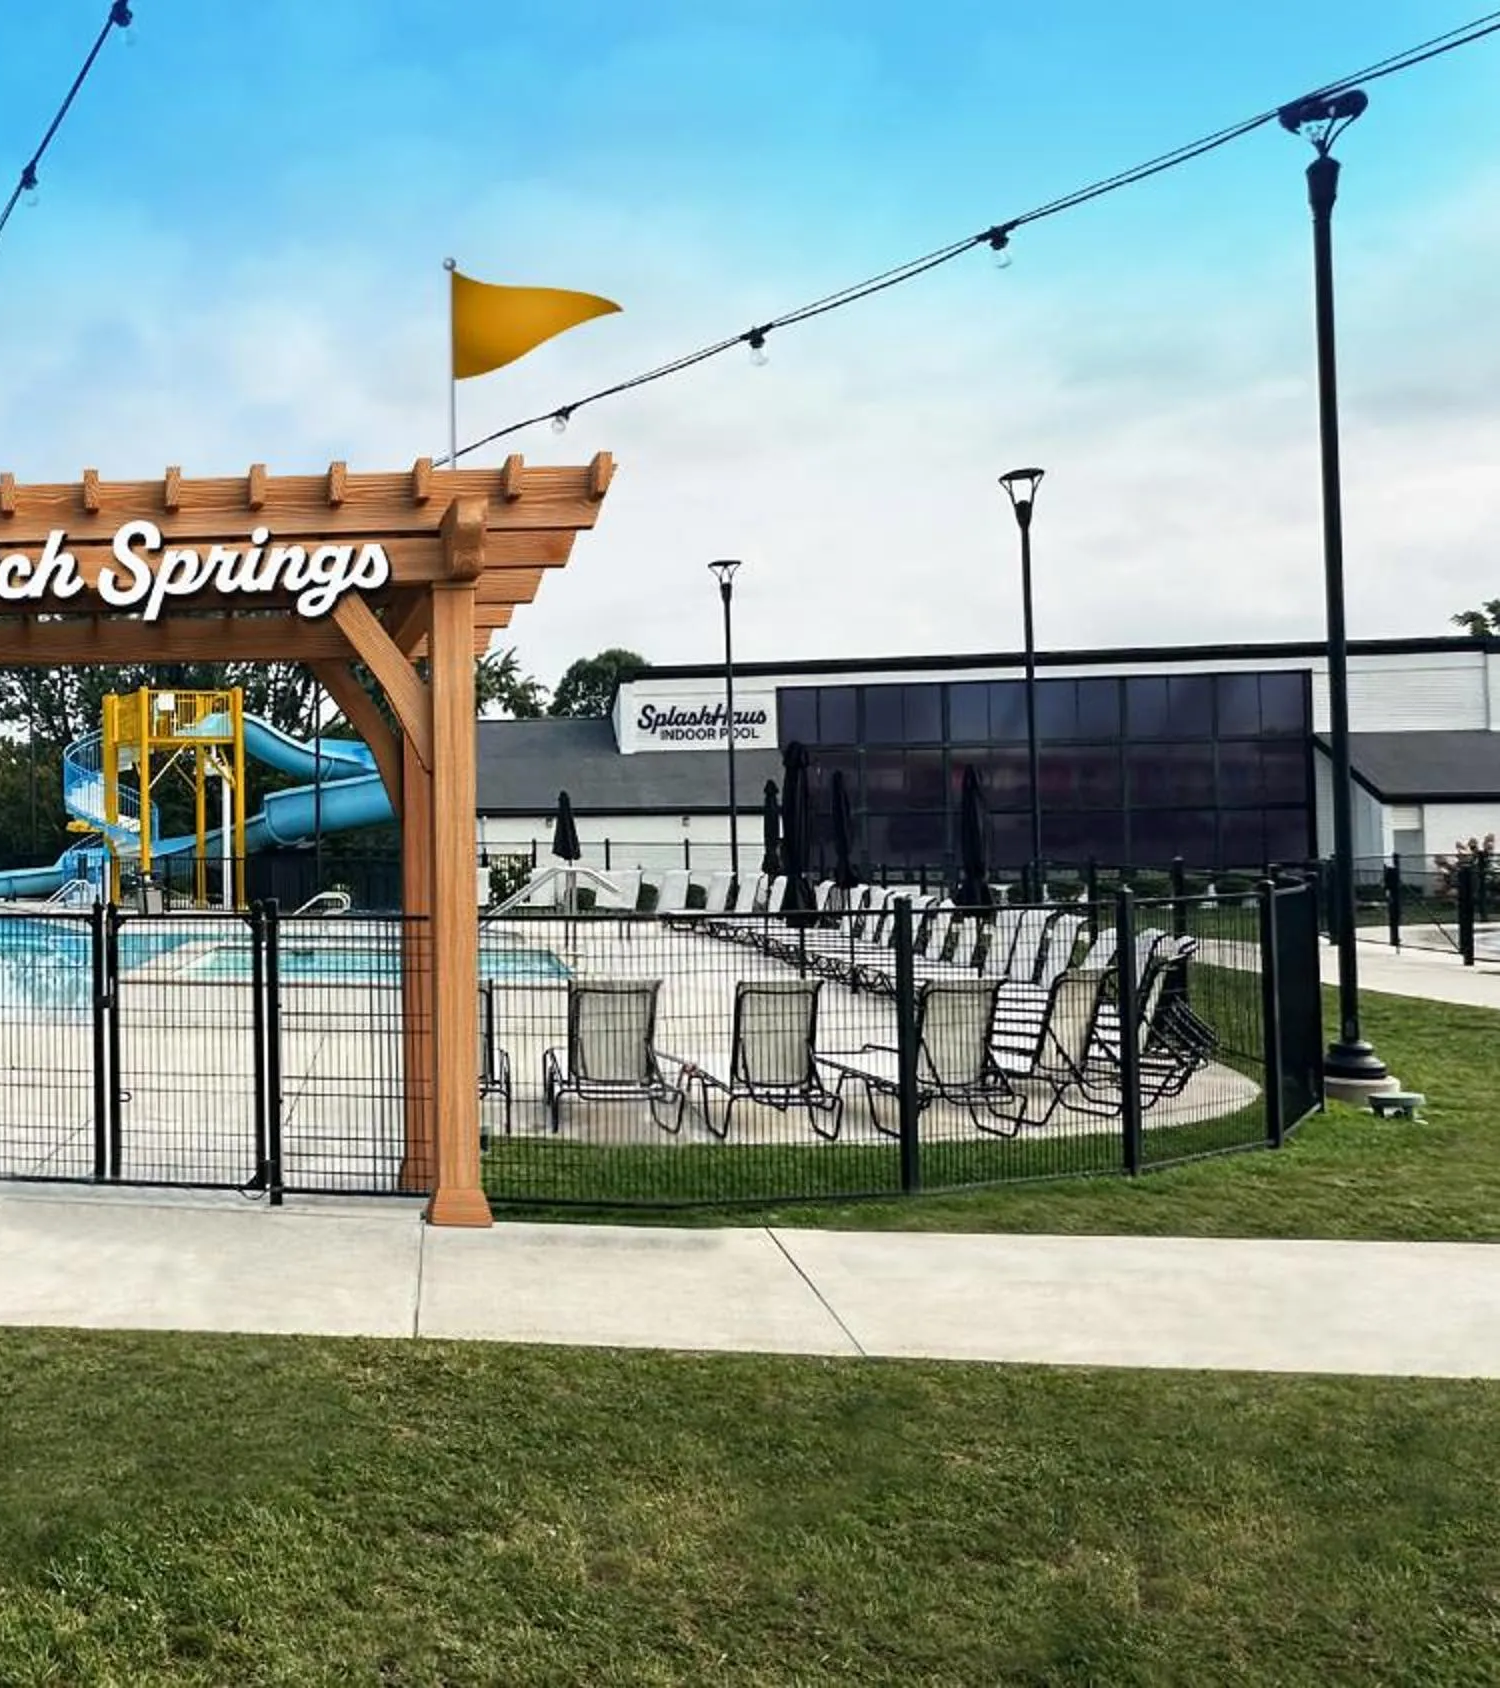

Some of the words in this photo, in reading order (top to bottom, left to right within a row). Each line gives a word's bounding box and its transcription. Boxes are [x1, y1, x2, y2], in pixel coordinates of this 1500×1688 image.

[98, 519, 390, 622] Springs
[637, 703, 767, 734] SplashHaus
[660, 728, 716, 740] INDOOR
